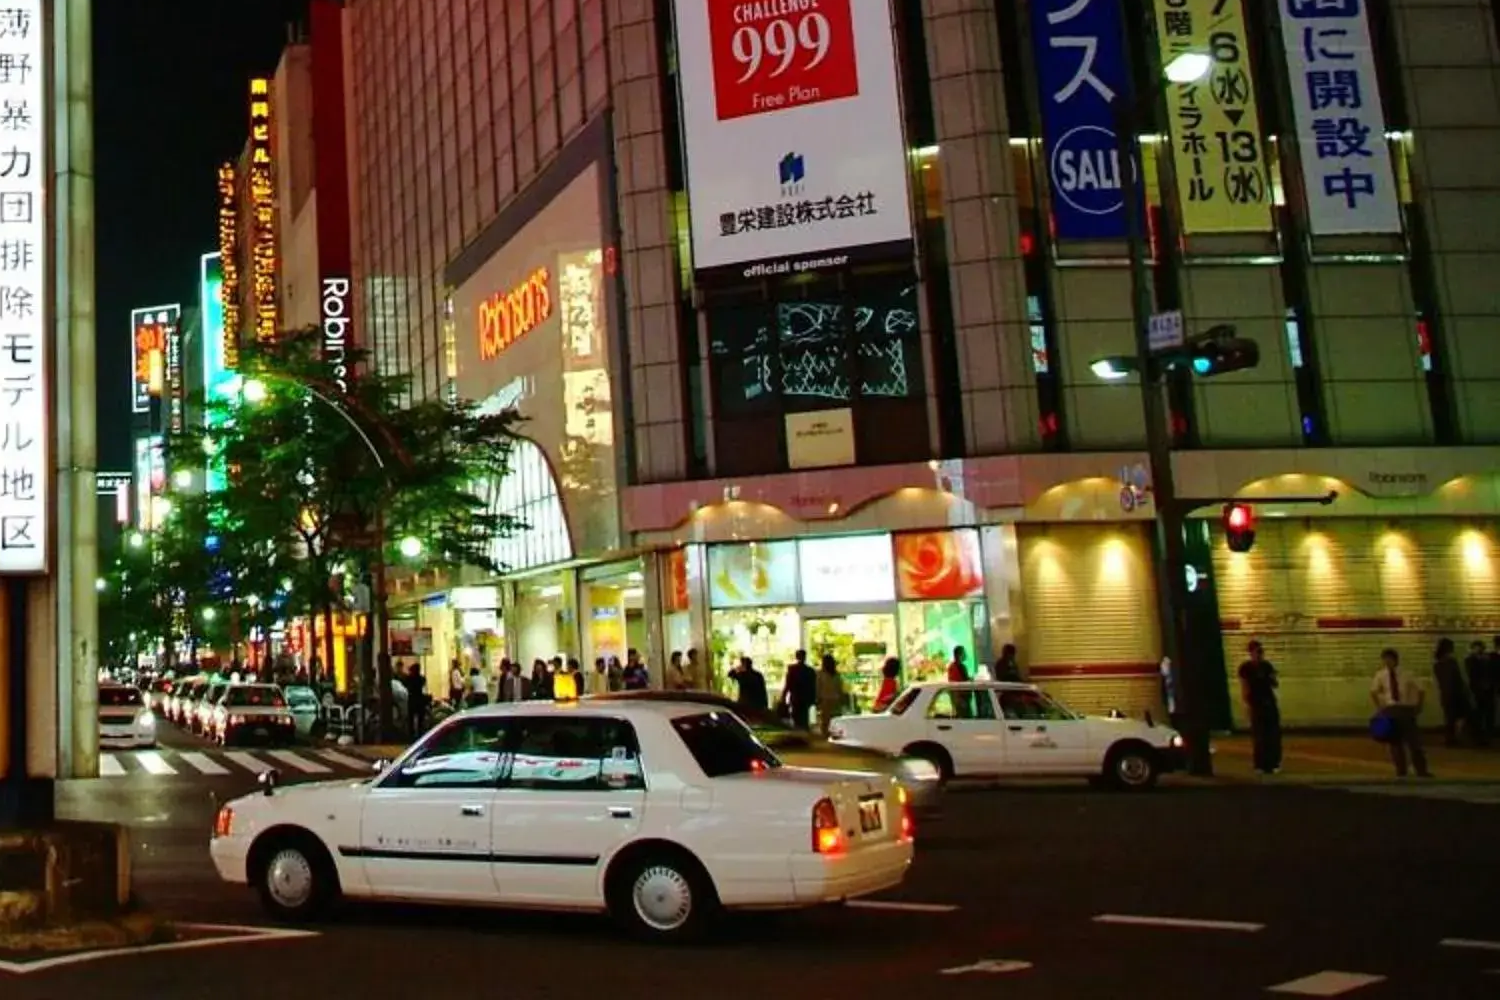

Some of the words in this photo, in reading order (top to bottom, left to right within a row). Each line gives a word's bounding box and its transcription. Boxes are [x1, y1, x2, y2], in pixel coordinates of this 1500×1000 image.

[731, 11, 831, 84] 999
[752, 91, 784, 109] Free
[789, 84, 821, 103] Plan
[743, 260, 790, 277] official
[793, 254, 848, 274] sponsor
